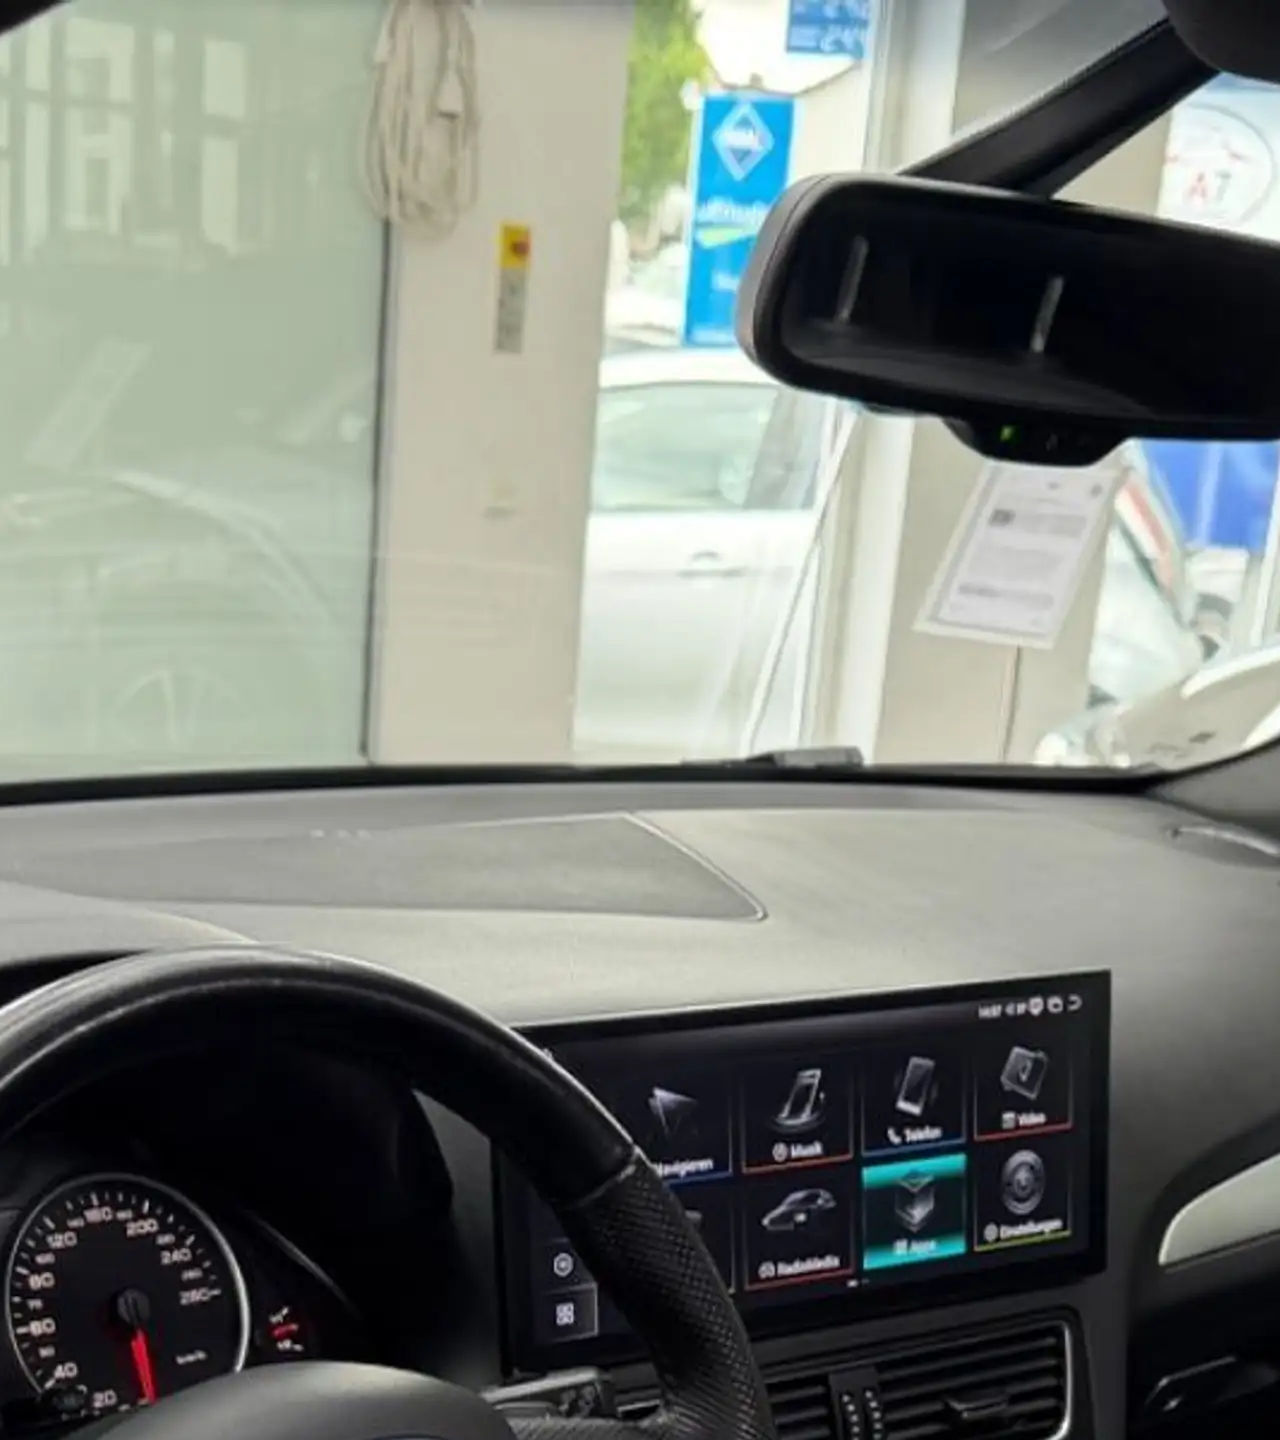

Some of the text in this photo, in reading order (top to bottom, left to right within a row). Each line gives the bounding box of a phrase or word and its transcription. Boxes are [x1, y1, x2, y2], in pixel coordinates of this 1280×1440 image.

[126, 1219, 158, 1237] 200
[48, 1232, 77, 1250] 120
[161, 1249, 191, 1265] 240
[54, 1362, 78, 1379] 40
